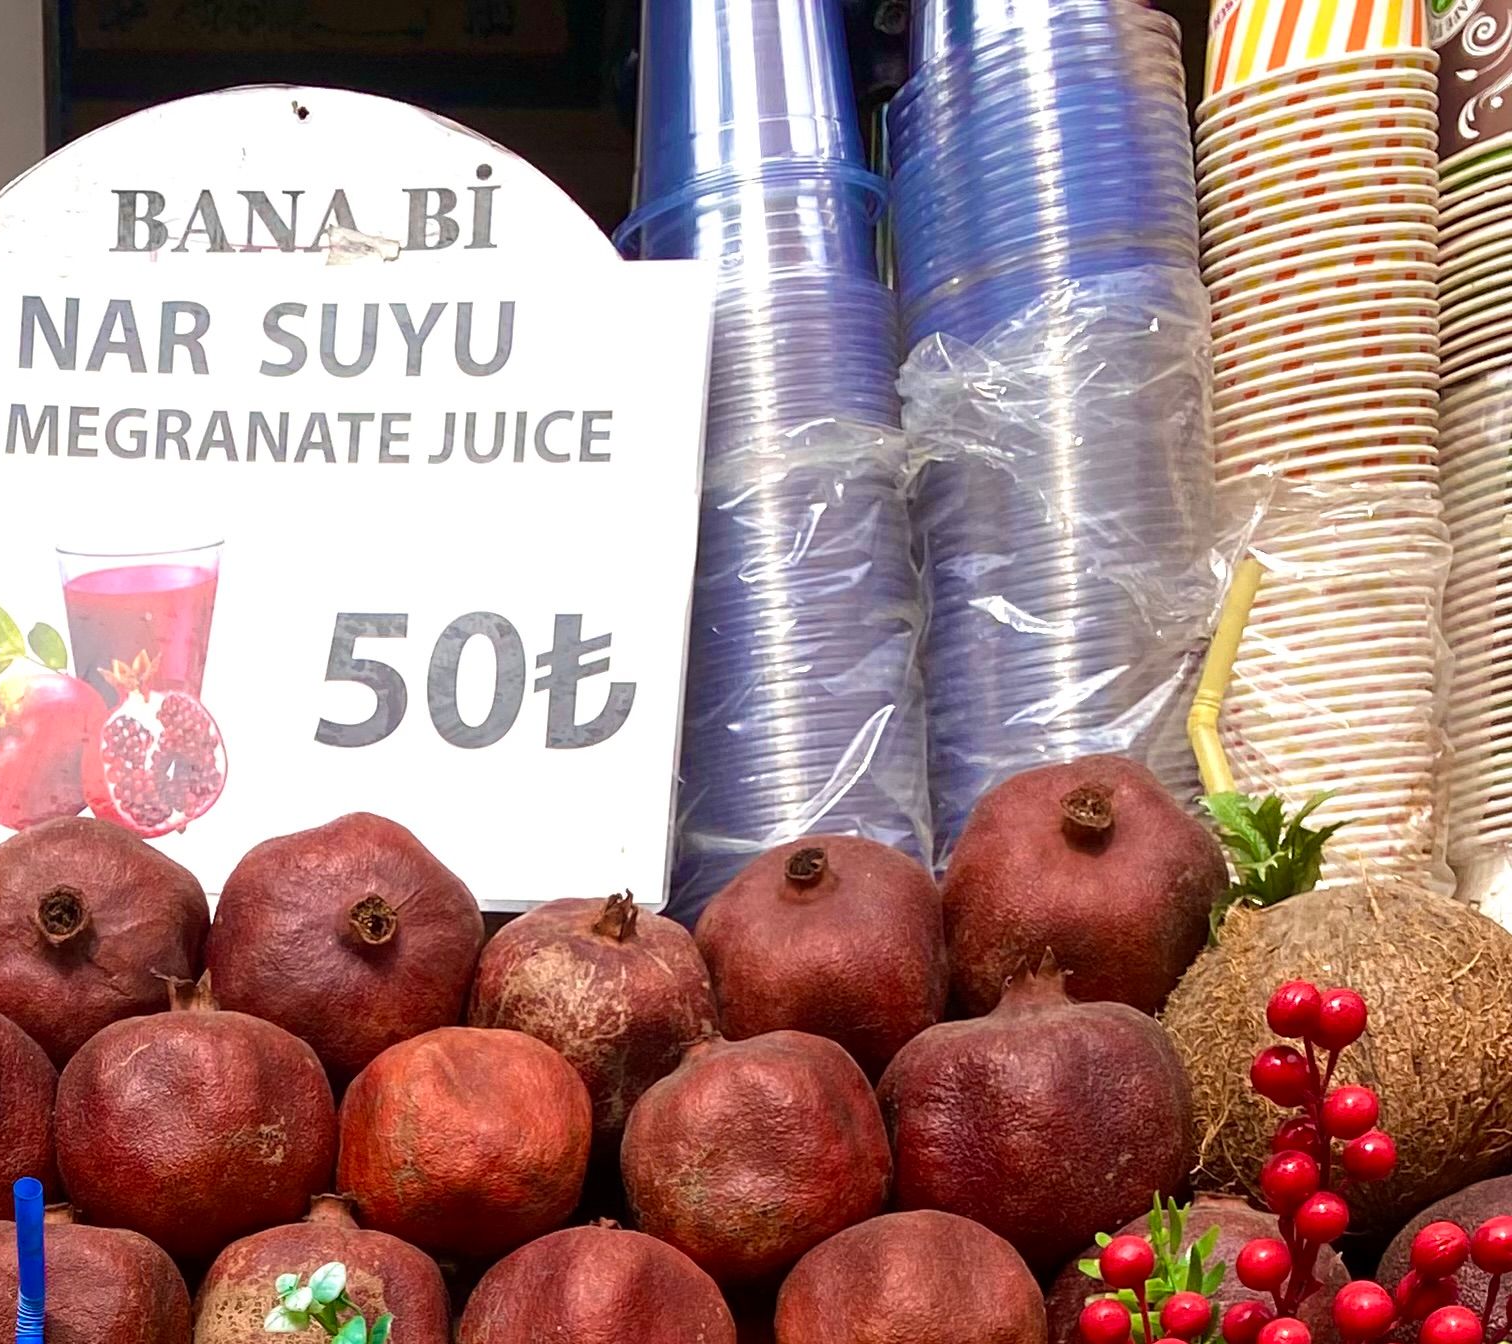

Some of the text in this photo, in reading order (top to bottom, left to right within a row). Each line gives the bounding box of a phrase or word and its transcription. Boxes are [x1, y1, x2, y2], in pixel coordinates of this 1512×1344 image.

[109, 189, 361, 253] BANA
[19, 296, 515, 378] NAR SUYU
[428, 410, 612, 464] JUICE
[314, 612, 636, 749] 50₺
